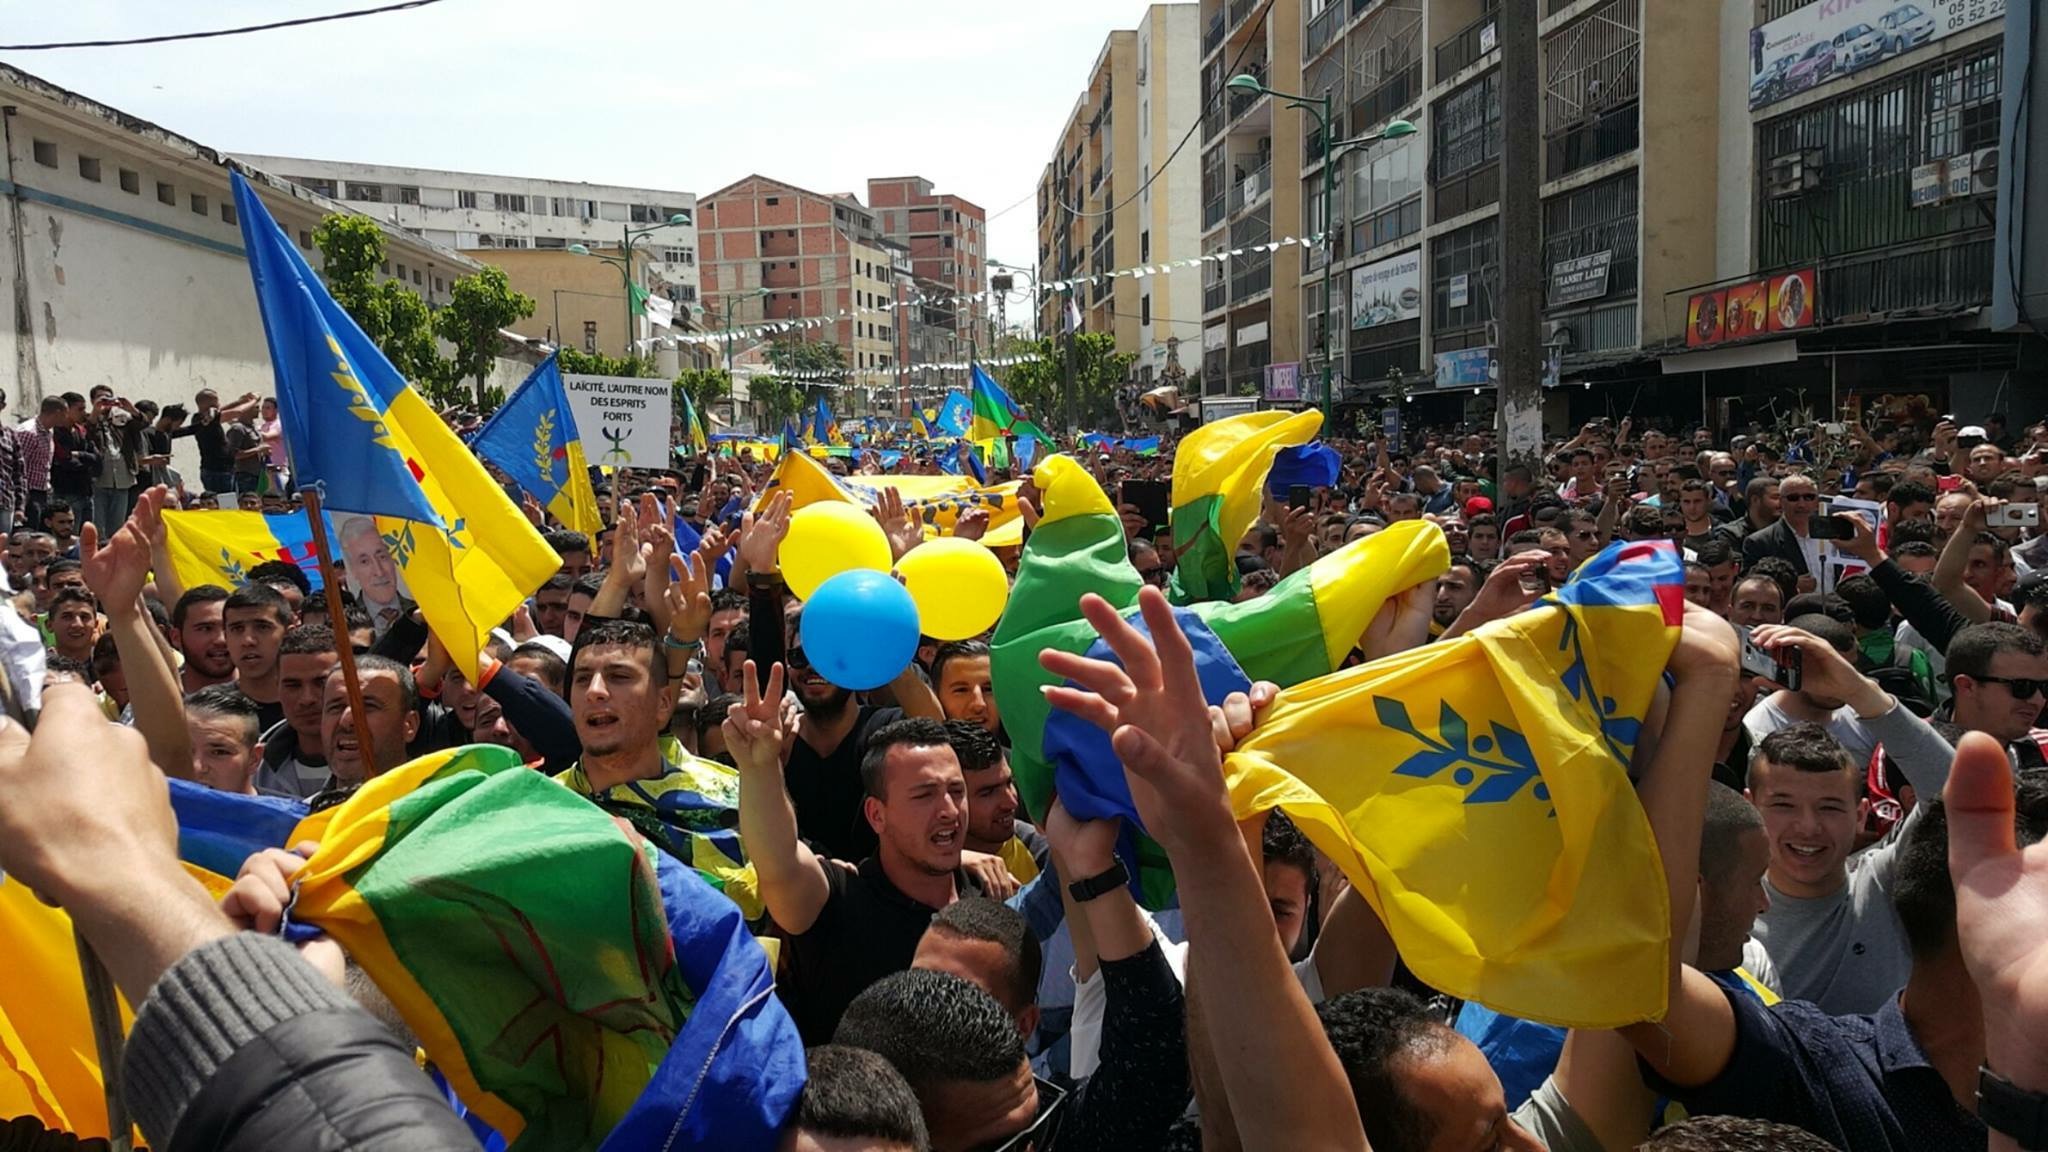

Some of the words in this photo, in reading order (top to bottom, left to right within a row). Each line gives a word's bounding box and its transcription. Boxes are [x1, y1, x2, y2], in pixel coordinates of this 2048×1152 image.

[1948, 14, 1964, 29] 05
[1969, 6, 1985, 21] 52
[569, 381, 606, 393] LAÏCITÉ,
[607, 383, 643, 395] L'AUTRE
[644, 385, 668, 396] NOM
[590, 397, 609, 407] DES
[610, 398, 646, 409] ESPRITS
[603, 411, 633, 422] FORTS
